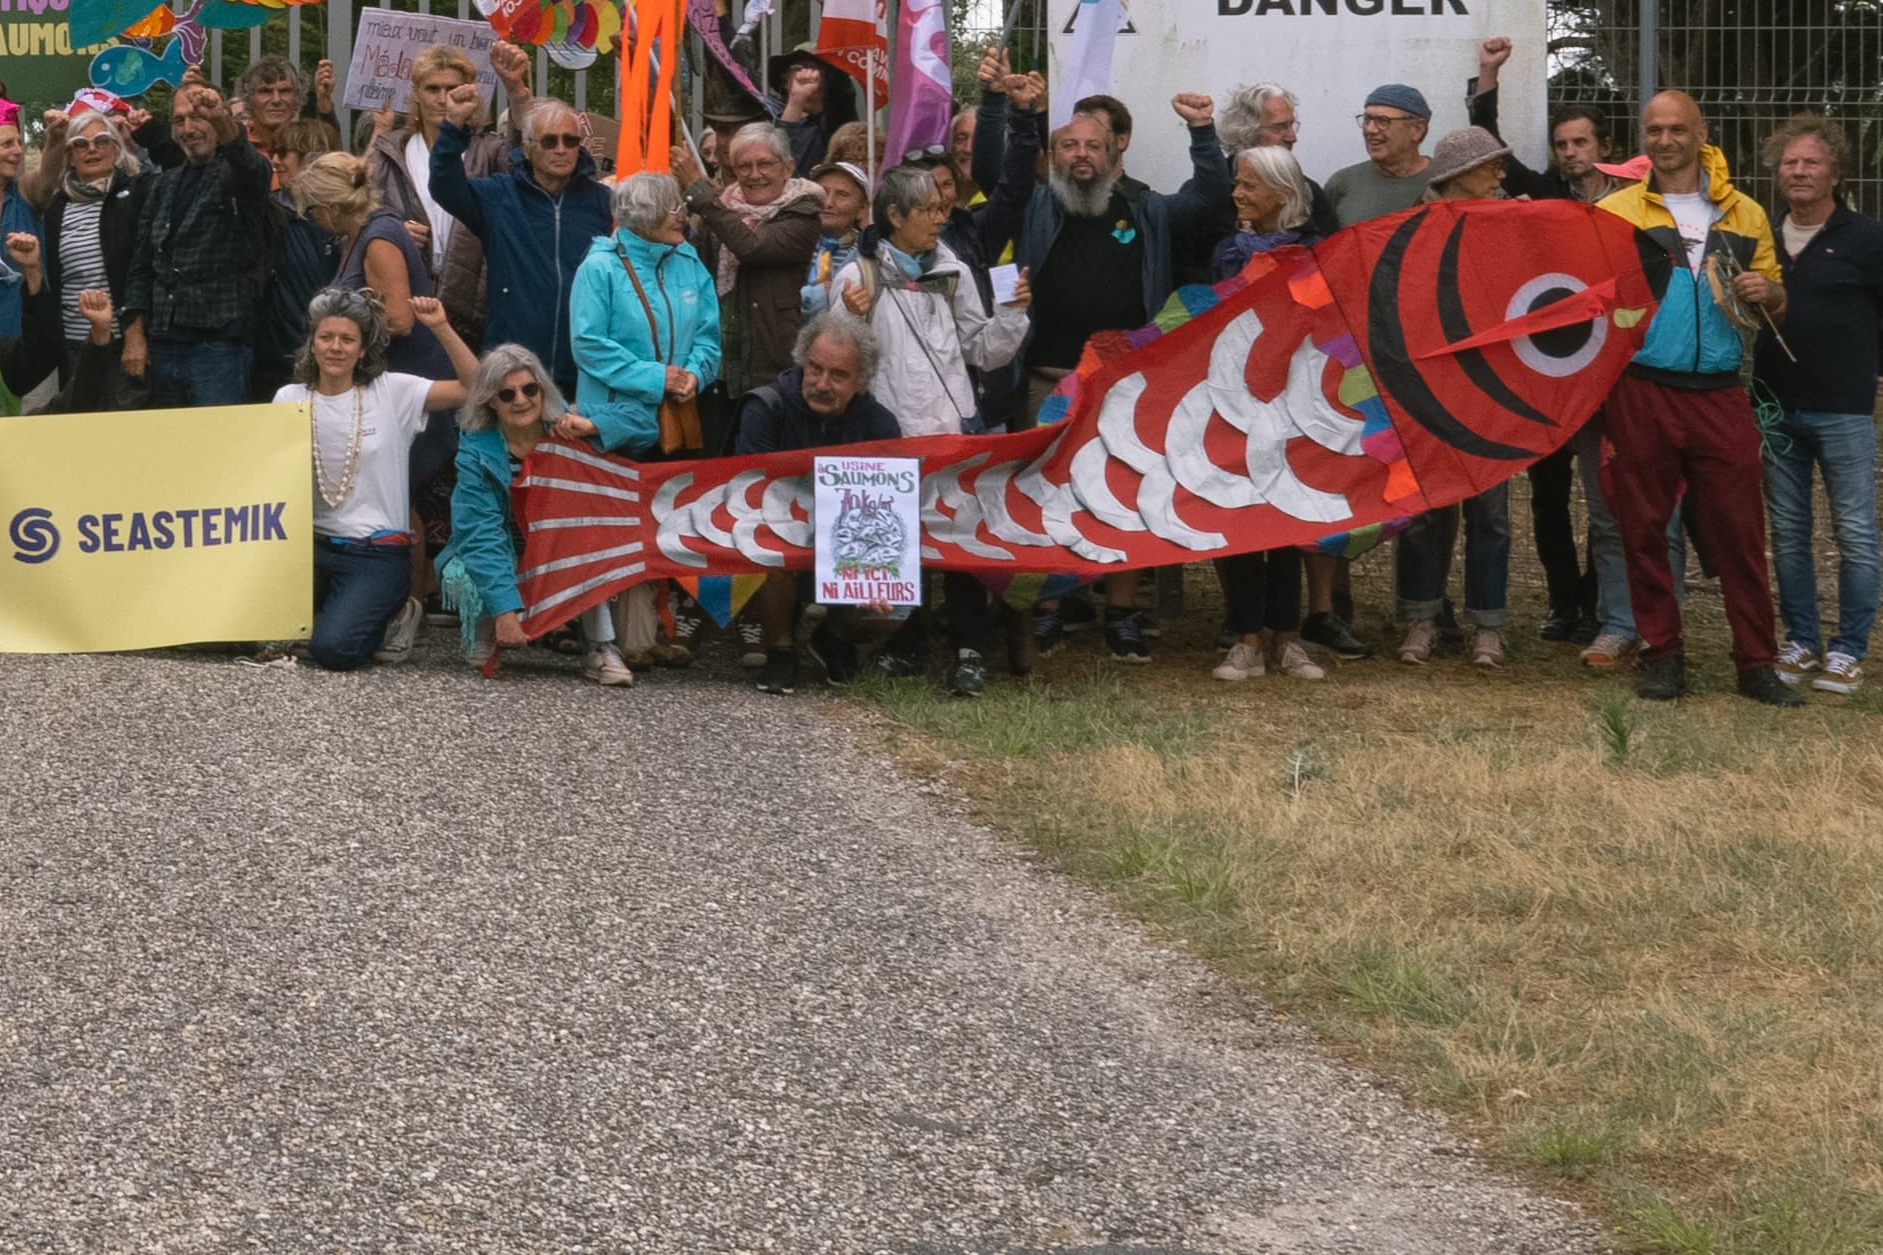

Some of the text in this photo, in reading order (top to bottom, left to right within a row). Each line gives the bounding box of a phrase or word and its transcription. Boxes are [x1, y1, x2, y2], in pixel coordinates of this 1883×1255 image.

[819, 464, 915, 493] SAUMONS
[842, 461, 885, 471] USINE
[77, 502, 287, 554] SEASTEMIK
